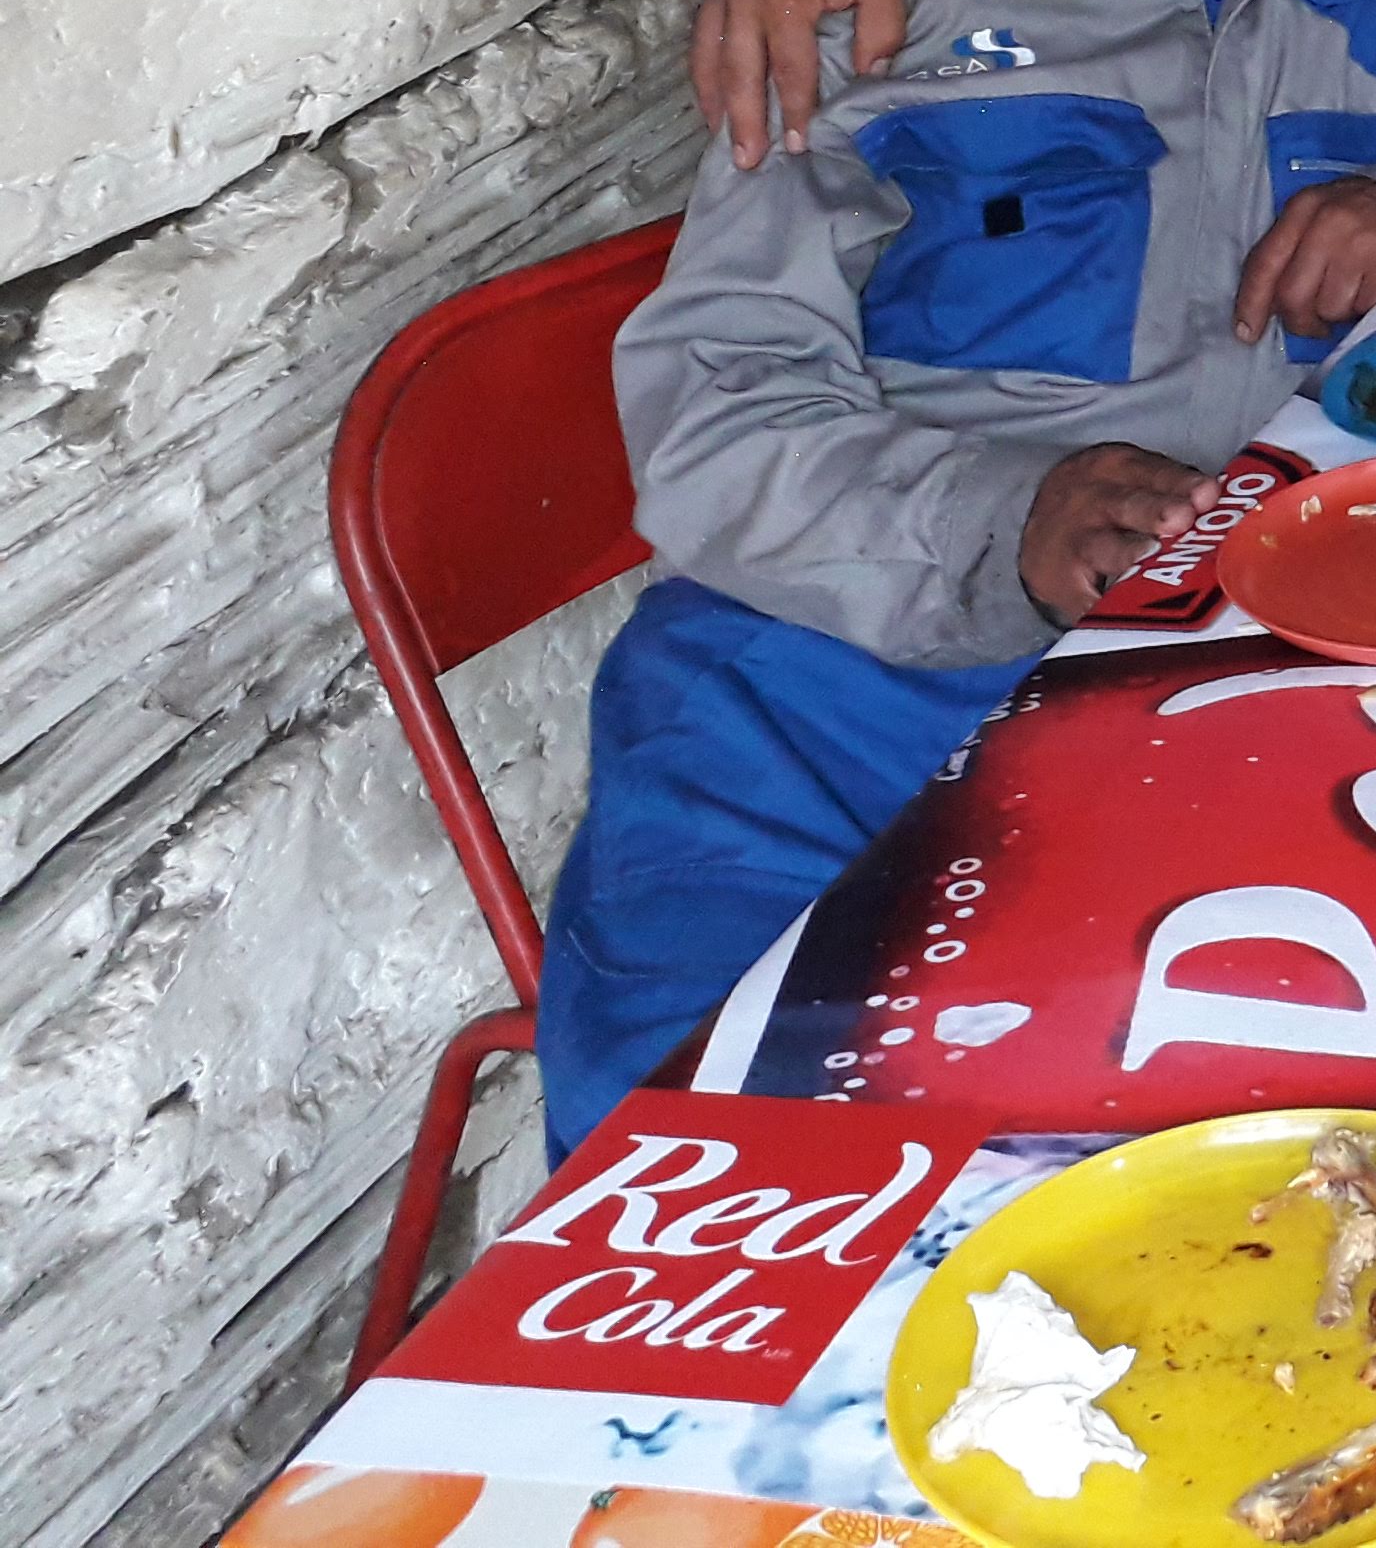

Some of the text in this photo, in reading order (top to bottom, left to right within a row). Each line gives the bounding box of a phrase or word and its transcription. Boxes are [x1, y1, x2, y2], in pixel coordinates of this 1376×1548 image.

[1142, 472, 1276, 586] ANTOJO
[495, 1134, 933, 1266] Red
[517, 1266, 786, 1351] Cola
